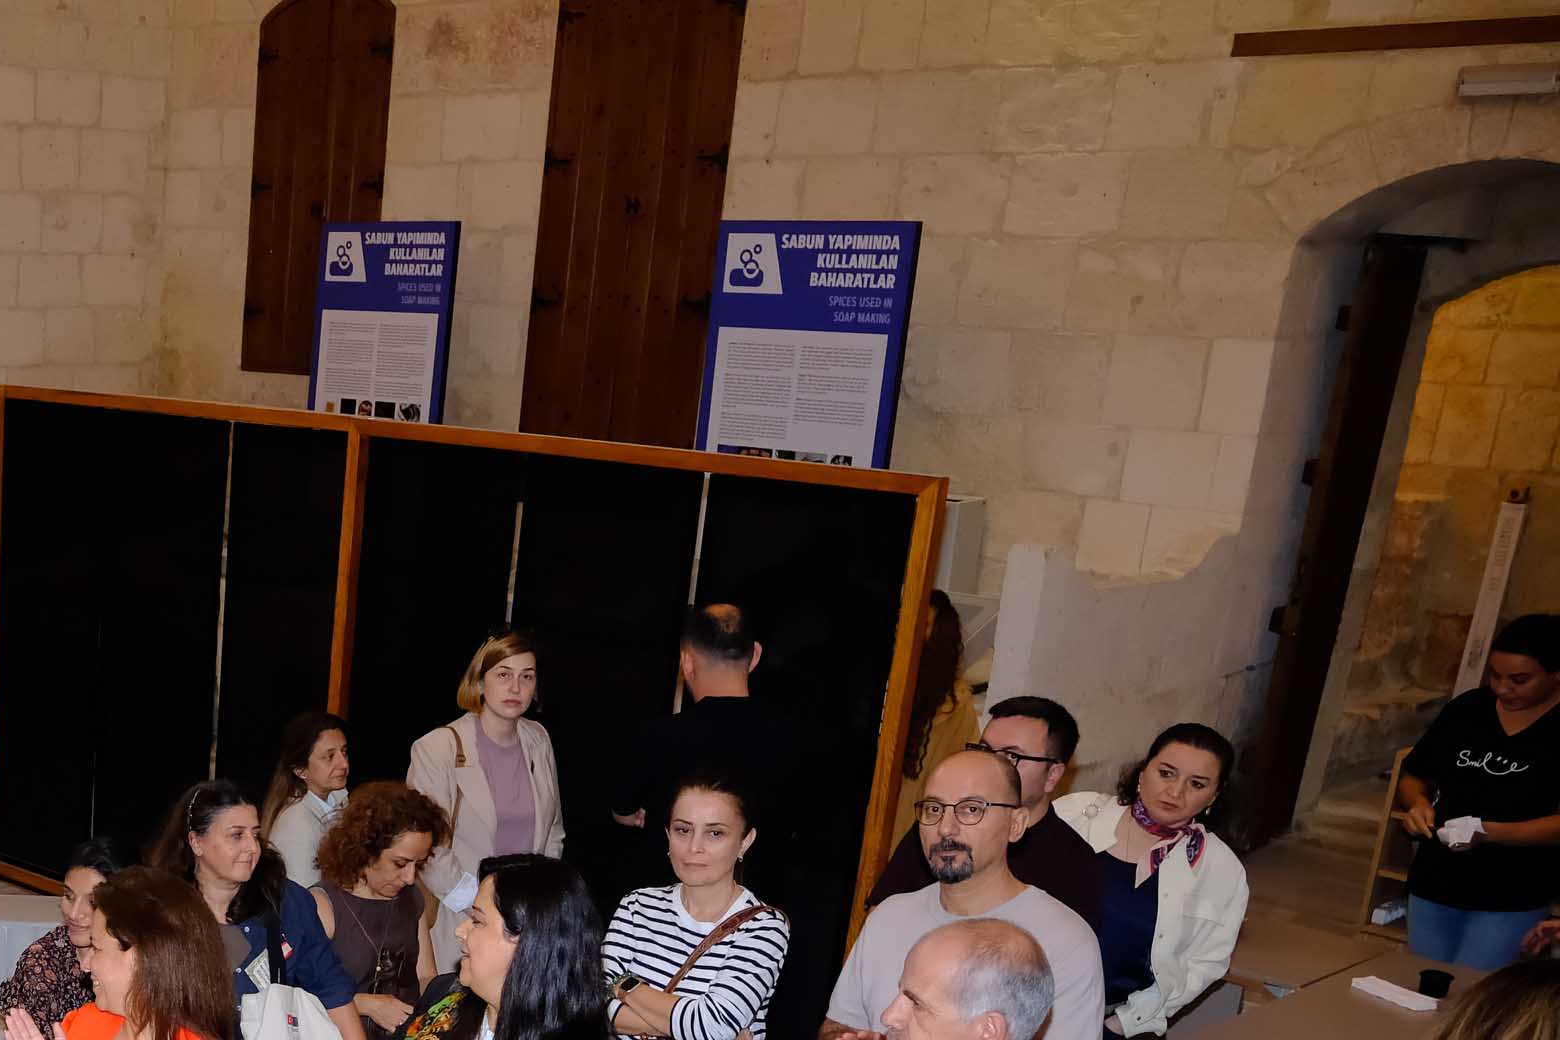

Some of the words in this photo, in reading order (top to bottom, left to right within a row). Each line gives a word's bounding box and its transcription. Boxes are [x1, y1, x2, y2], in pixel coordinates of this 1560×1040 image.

[365, 231, 394, 245] SABUN
[396, 231, 446, 245] YAPIMINDA
[781, 233, 825, 249] SABUN
[828, 234, 900, 250] YAPIMINDA
[389, 247, 445, 261] KULLANILAN
[816, 253, 899, 270] KULLANILAN
[384, 263, 444, 277] BAHARATLAR
[809, 271, 896, 289] BAHARATLAR
[828, 295, 857, 307] SPICES
[858, 296, 881, 308] USED
[883, 297, 893, 309] IN
[833, 311, 856, 322] SOAP
[857, 312, 890, 324] MAKING
[1456, 749, 1530, 775] Smile
